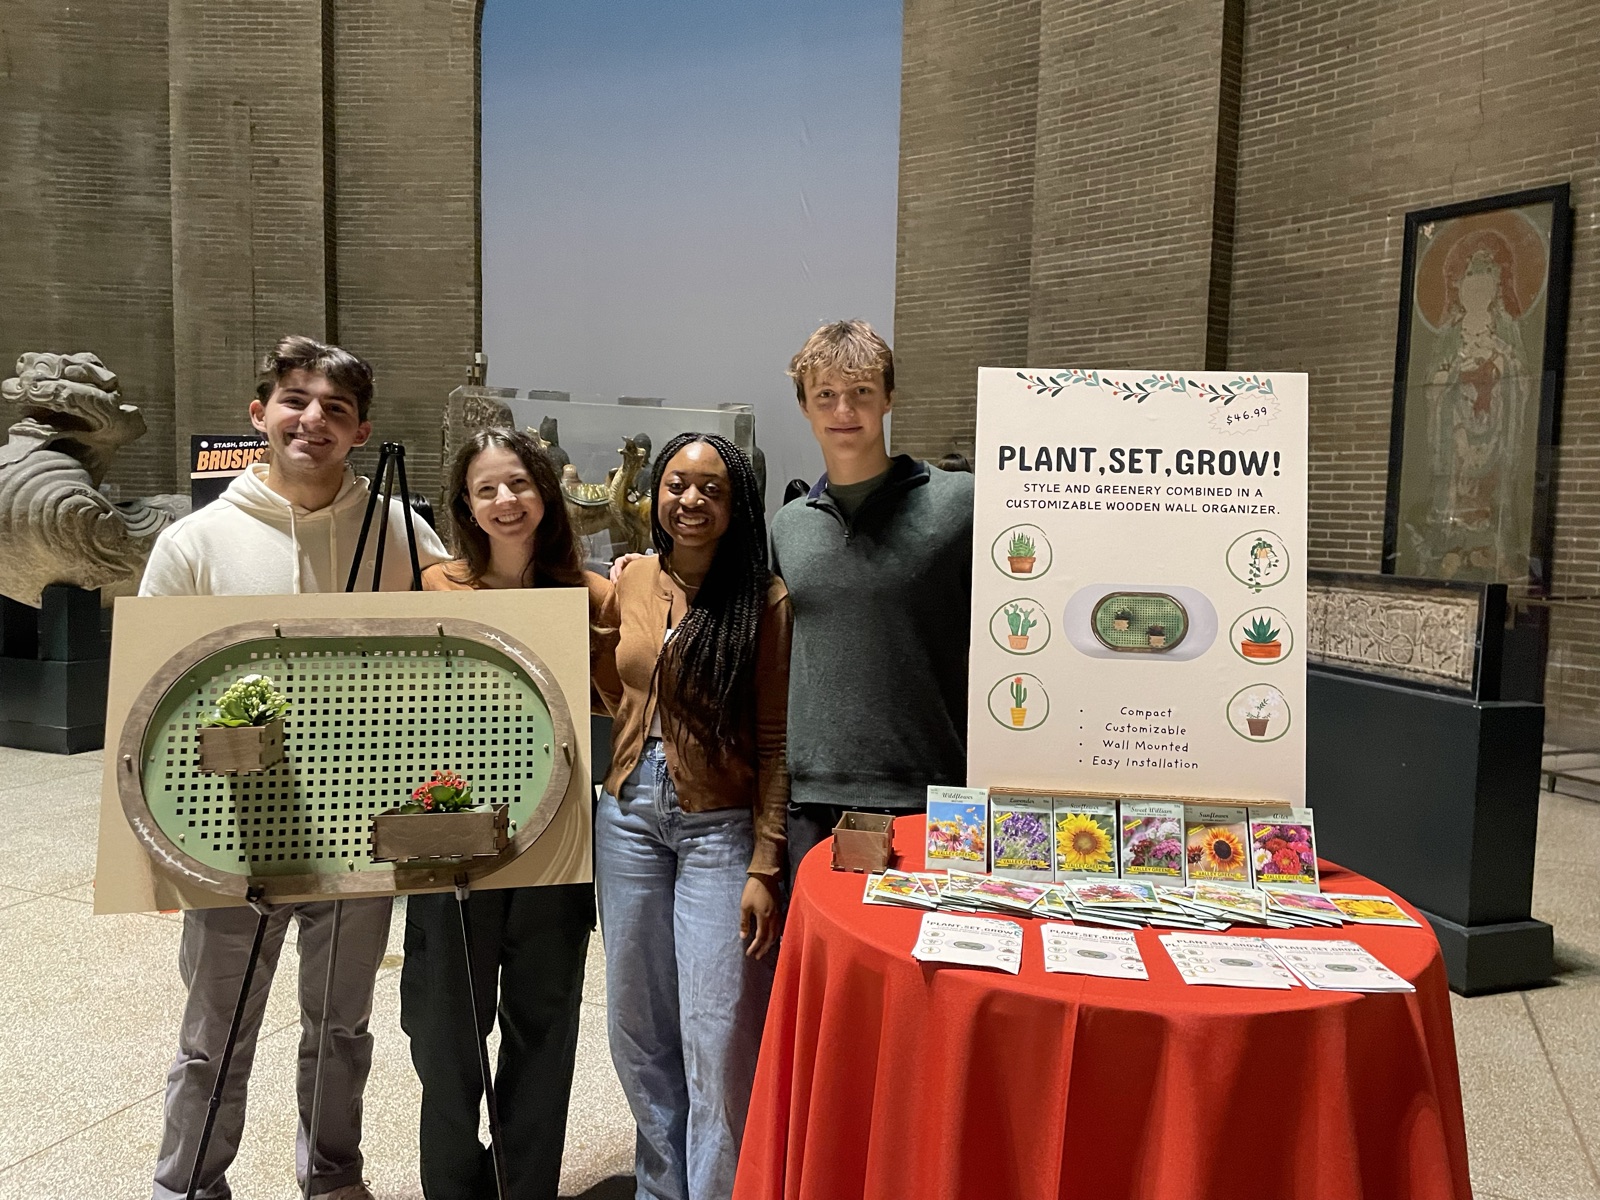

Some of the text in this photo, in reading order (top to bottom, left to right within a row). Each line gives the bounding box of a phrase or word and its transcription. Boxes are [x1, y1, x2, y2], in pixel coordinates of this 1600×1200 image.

[1226, 406, 1267, 426] $46.99
[1023, 483, 1263, 497] STYLE AND GREENERY COMBINED IN A
[1006, 499, 1280, 515] CUSTOMIZABLE WOODEN WALL ORGANIZER.
[1120, 706, 1172, 720] Compact
[1105, 722, 1187, 736] Customizable
[1102, 739, 1189, 753] Wall Mounted
[1092, 755, 1198, 769] Easy Installation
[942, 791, 974, 800] Wildflower
[1149, 807, 1173, 815] William
[1198, 812, 1229, 820] Sunflower
